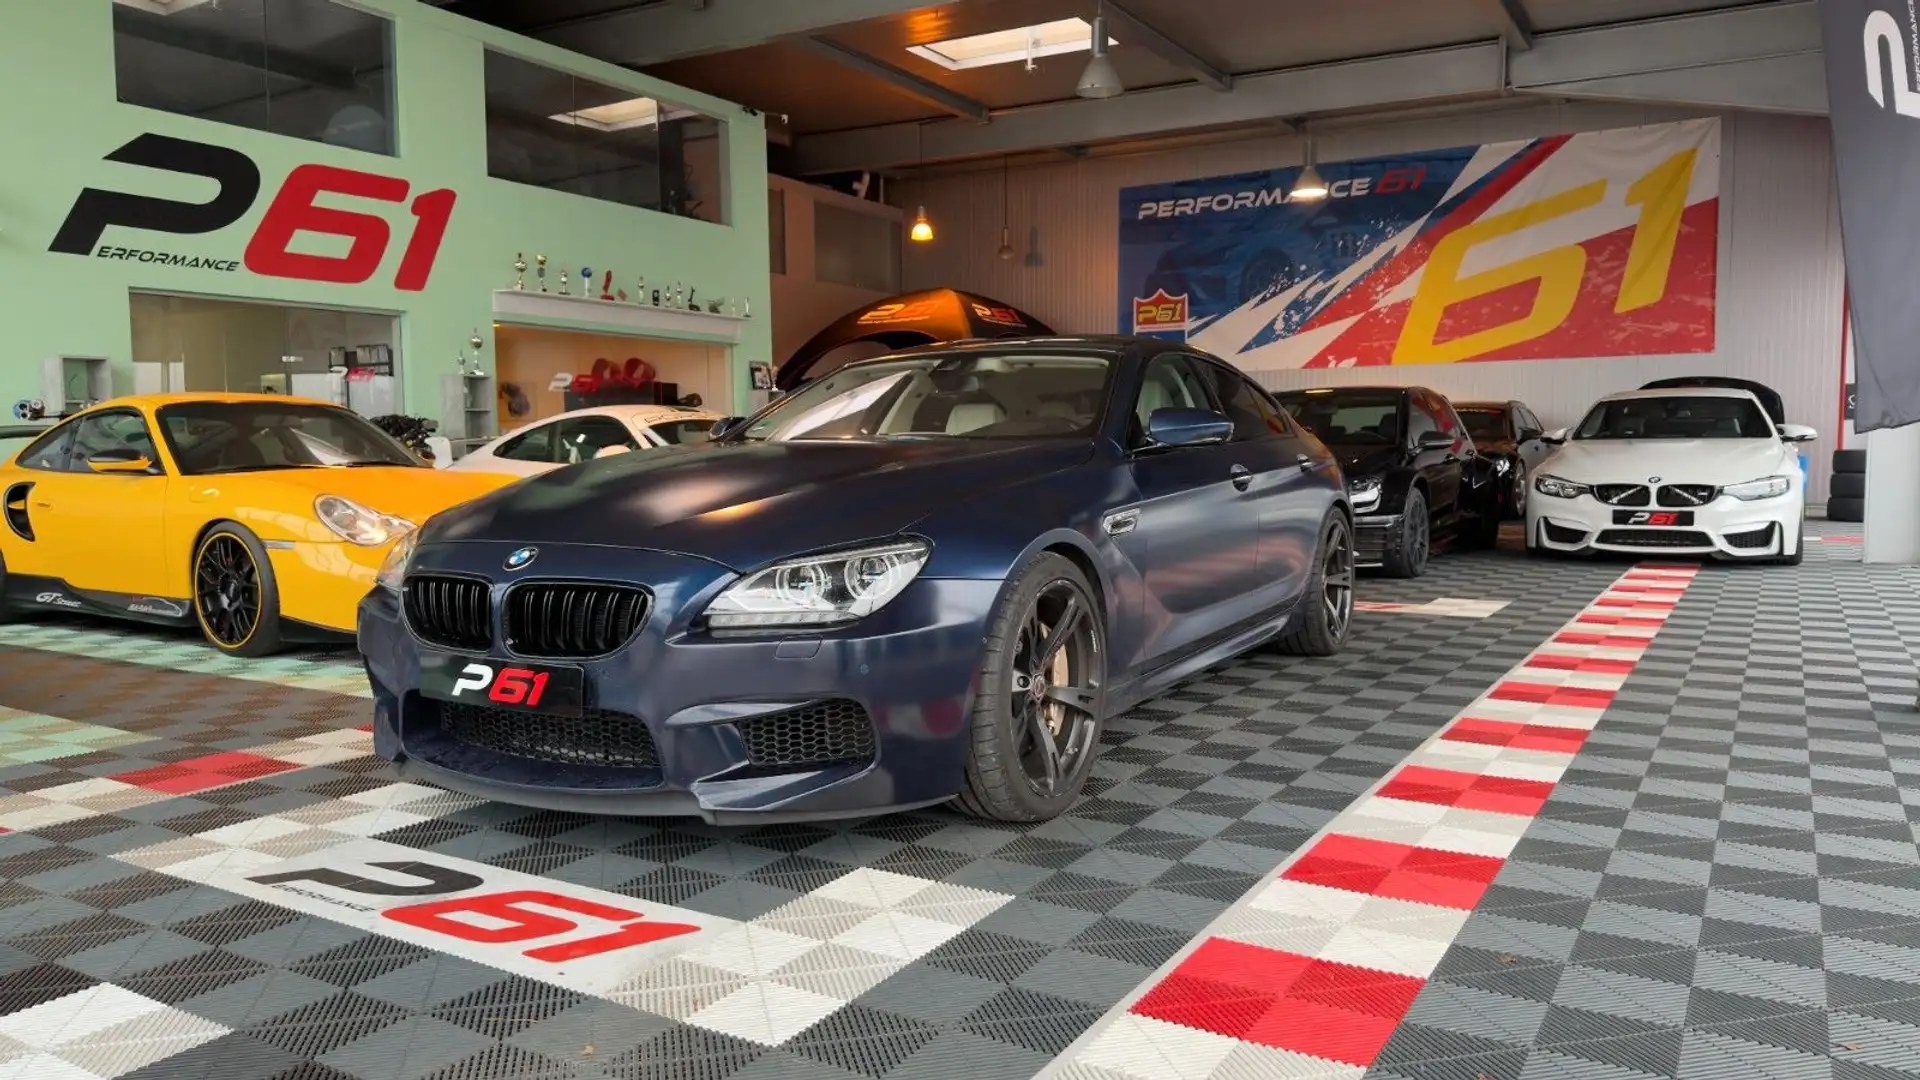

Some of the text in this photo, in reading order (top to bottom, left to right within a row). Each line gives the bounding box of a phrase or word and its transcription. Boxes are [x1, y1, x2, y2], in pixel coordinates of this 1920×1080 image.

[1376, 167, 1427, 193] 61
[48, 132, 457, 291] P61
[1393, 146, 1697, 365] 61
[1138, 303, 1182, 323] P61
[1627, 512, 1679, 525] P61
[452, 663, 550, 706] P61
[245, 861, 702, 963] P61
